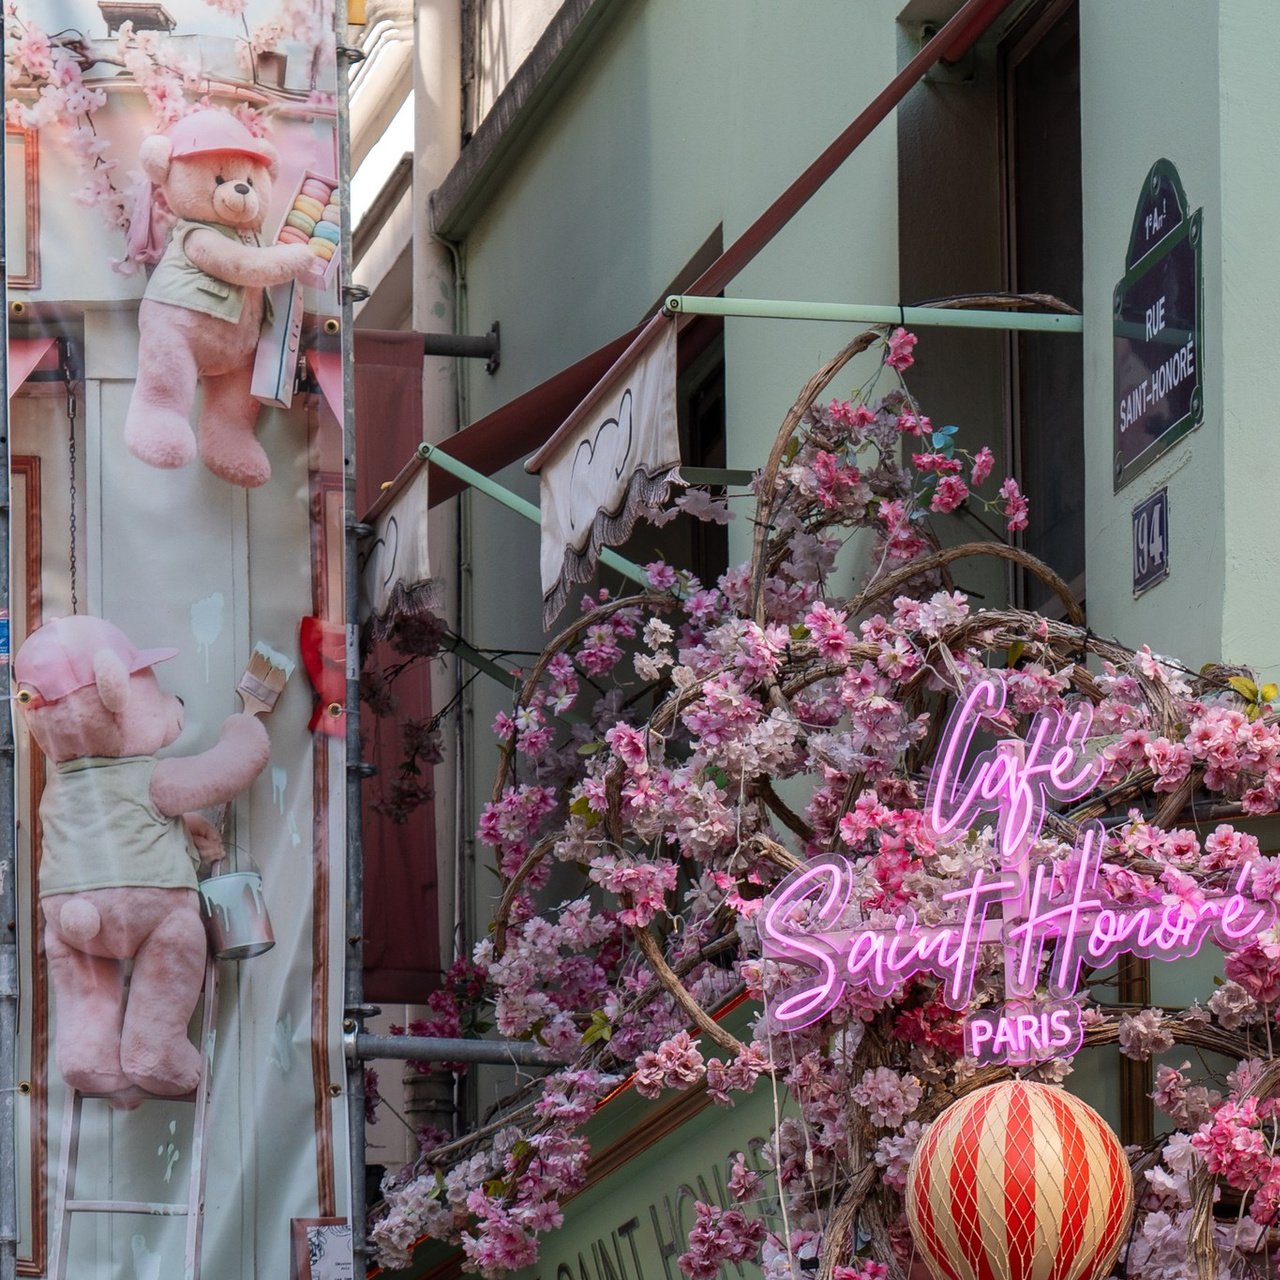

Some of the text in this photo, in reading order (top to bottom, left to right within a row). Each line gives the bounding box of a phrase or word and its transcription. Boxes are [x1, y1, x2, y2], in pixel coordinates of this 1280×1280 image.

[1145, 295, 1166, 342] RUE
[1120, 333, 1194, 432] SAINT-HONORÉ
[1134, 503, 1164, 580] 194
[932, 680, 1093, 857] Café
[765, 829, 1265, 1020] Saint Honoré
[970, 1010, 1072, 1057] PARIS
